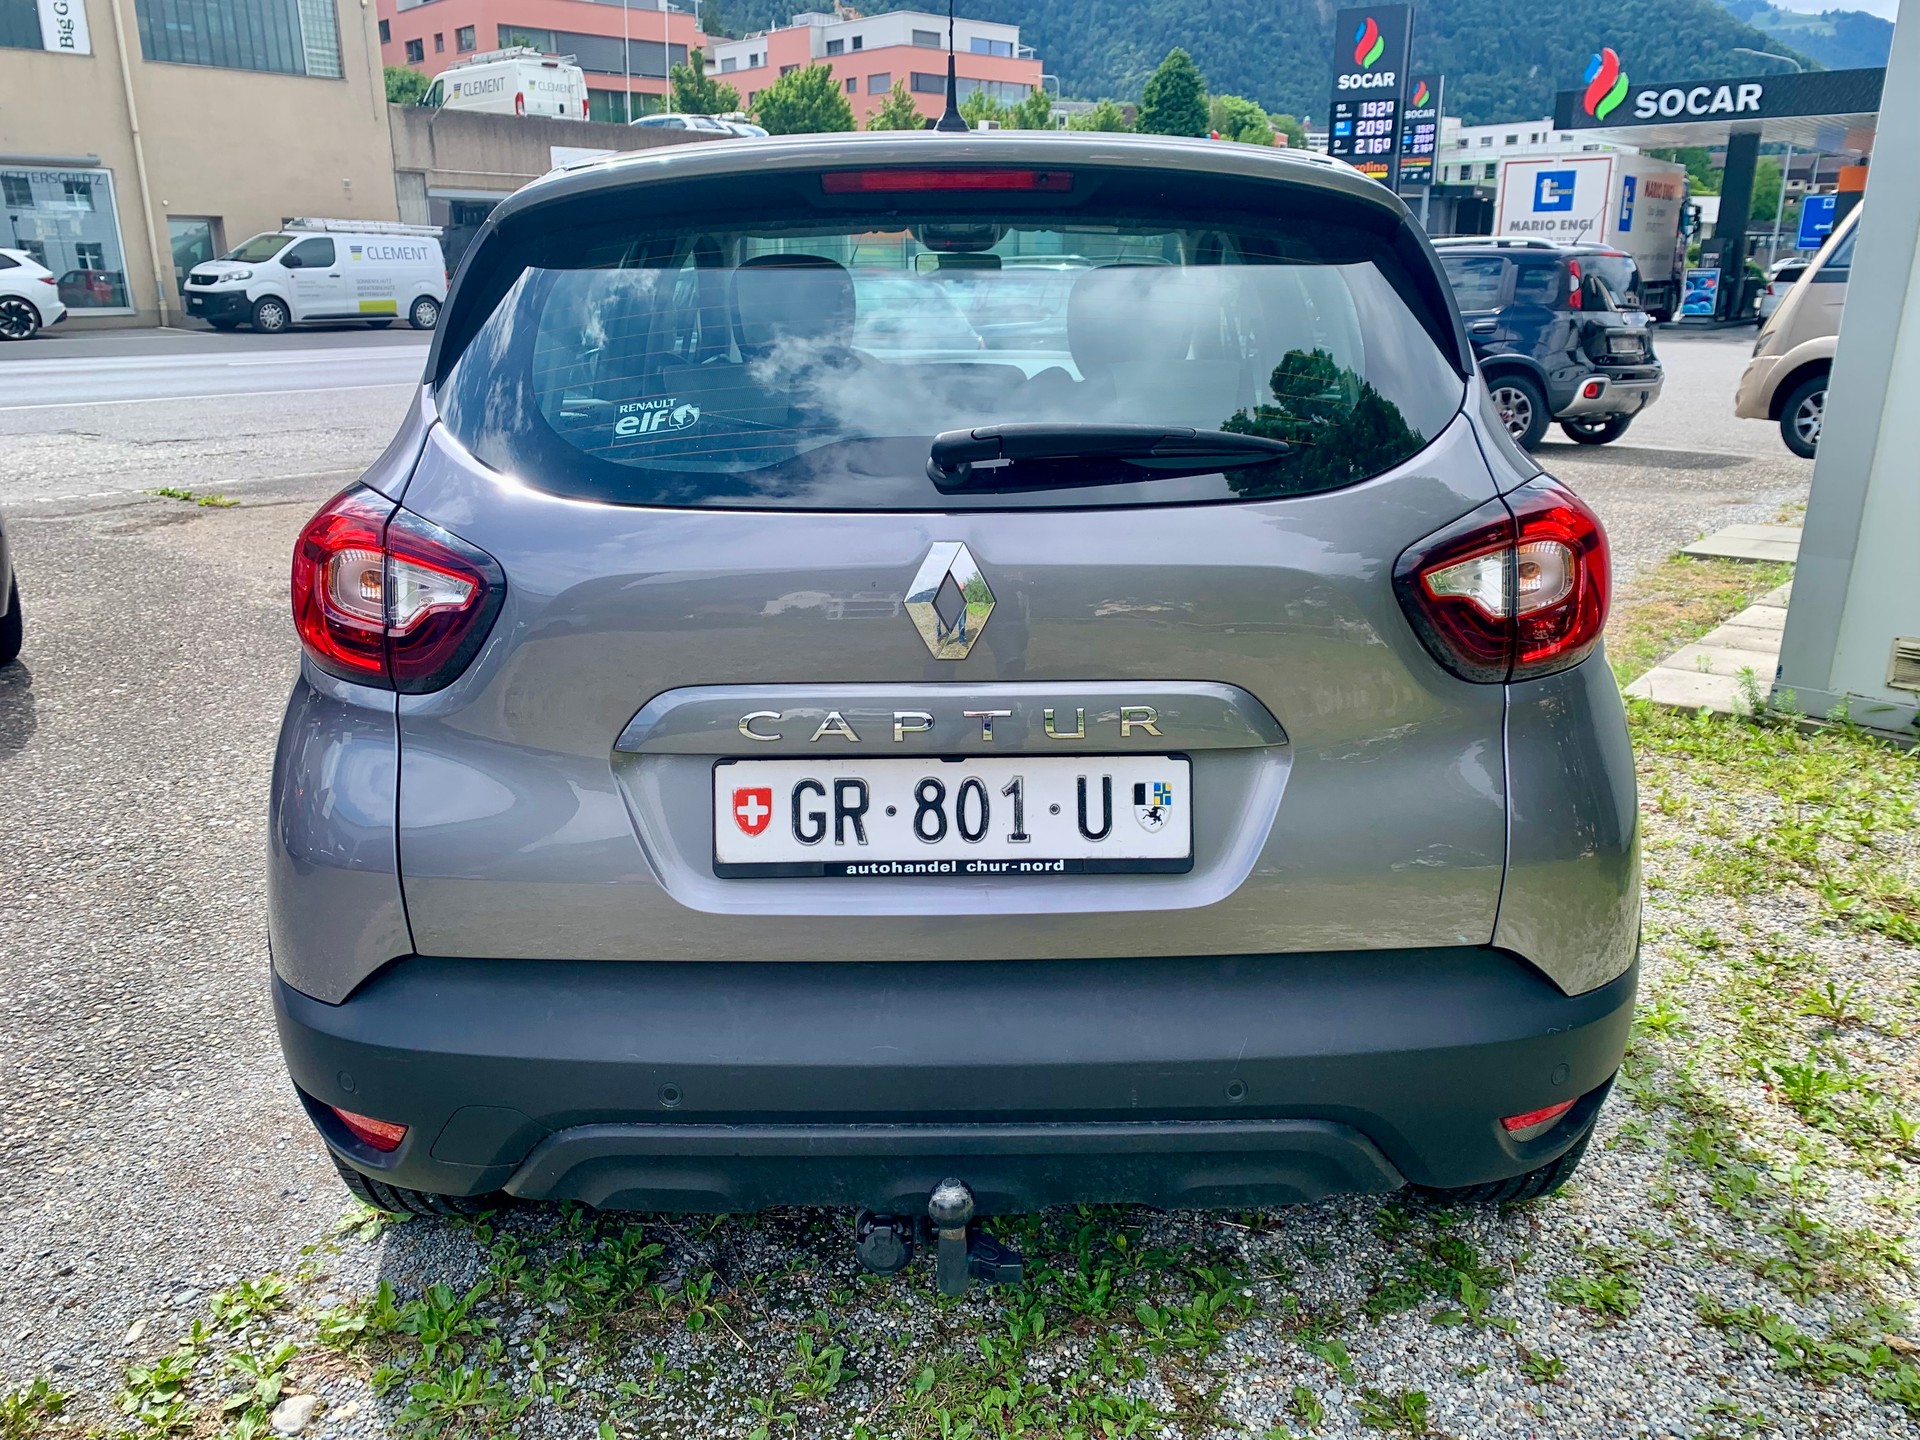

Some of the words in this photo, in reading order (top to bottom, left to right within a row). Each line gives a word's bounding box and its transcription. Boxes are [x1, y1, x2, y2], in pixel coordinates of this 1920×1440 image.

[54, 1, 69, 16] G
[57, 18, 74, 49] Big
[463, 77, 505, 96] CLEMENT
[538, 81, 575, 94] CLEMENT
[1337, 72, 1395, 90] SOCAR
[1633, 83, 1763, 119] SOCAR
[1404, 109, 1436, 120] SOCAR
[1509, 220, 1556, 232] MARIO
[1560, 218, 1594, 231] ENGI
[367, 246, 428, 260] CLEMENT
[620, 398, 676, 414] RENAULT
[615, 409, 668, 435] elf
[737, 705, 1165, 743] CAPTUR
[846, 860, 958, 875] autohandel
[965, 859, 1065, 874] chur-nord
